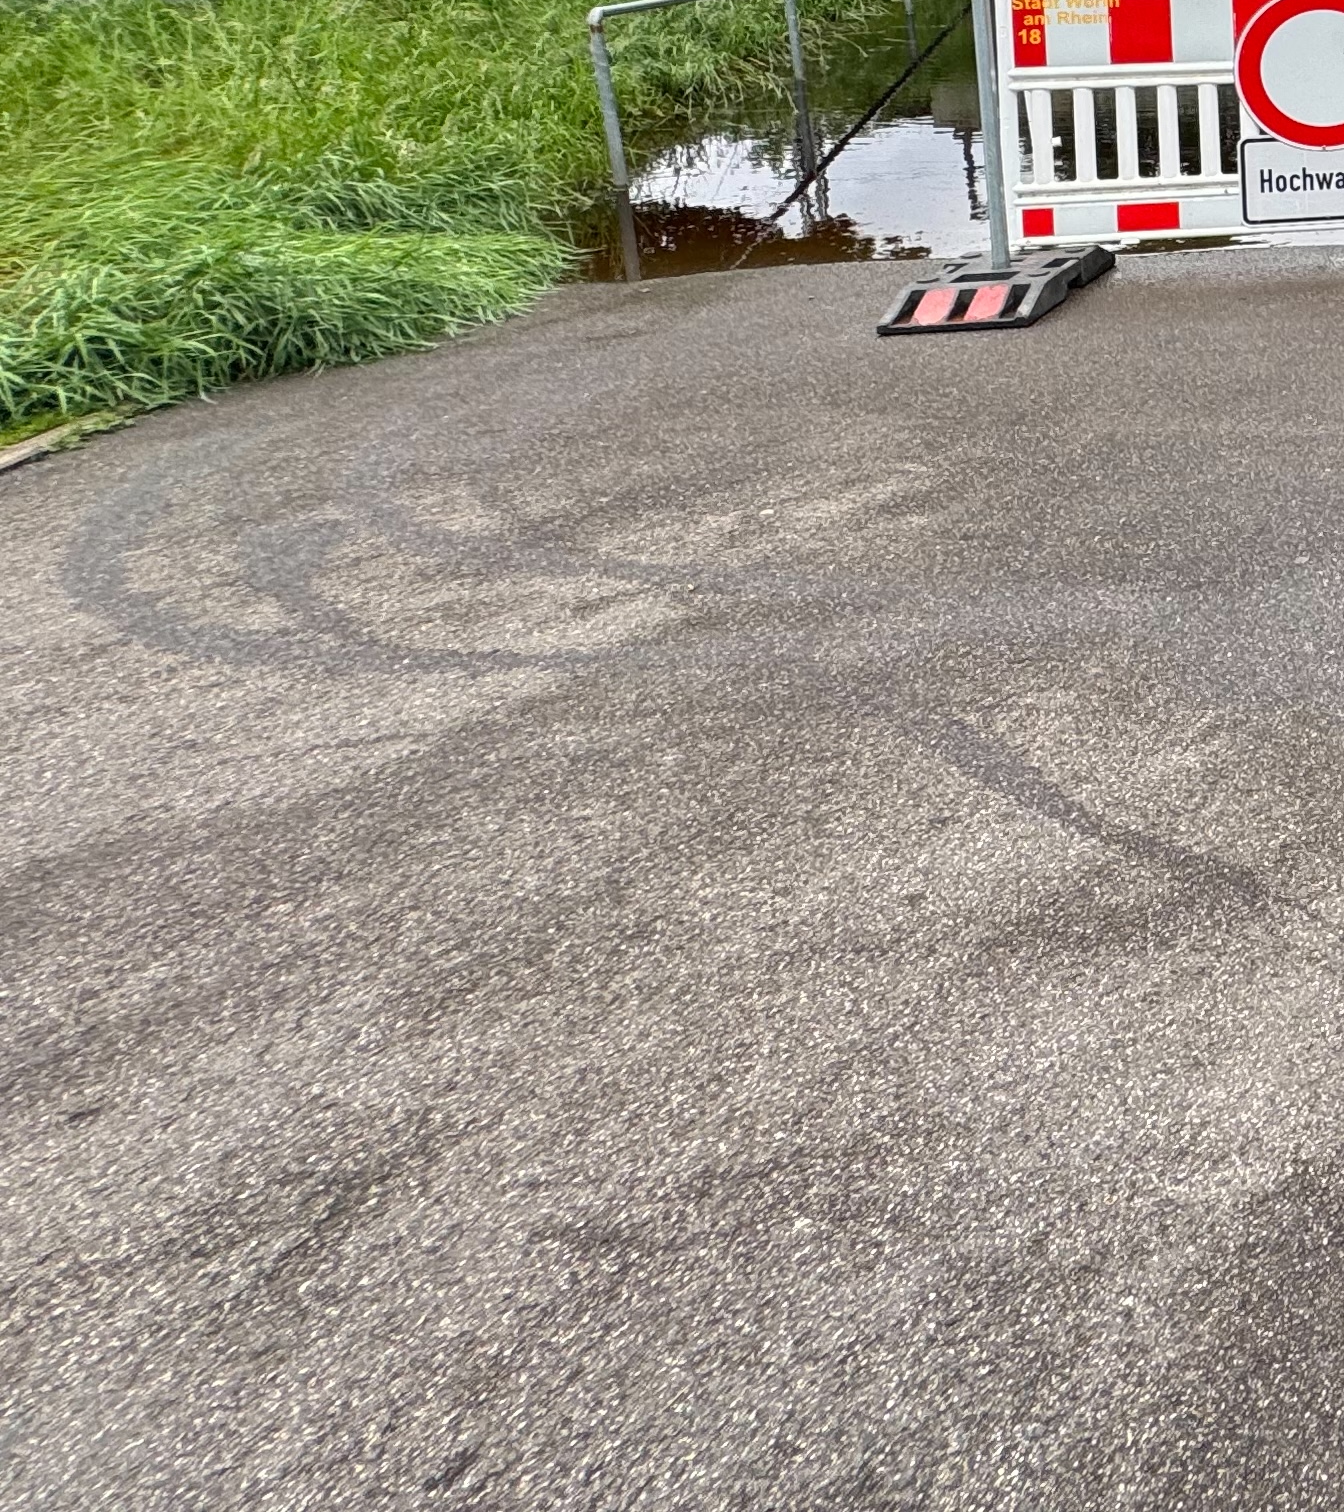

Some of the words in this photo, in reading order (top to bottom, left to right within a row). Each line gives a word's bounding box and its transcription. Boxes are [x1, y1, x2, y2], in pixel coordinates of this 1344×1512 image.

[1023, 14, 1051, 26] am
[1057, 11, 1112, 25] Rhein
[1018, 28, 1042, 45] 18
